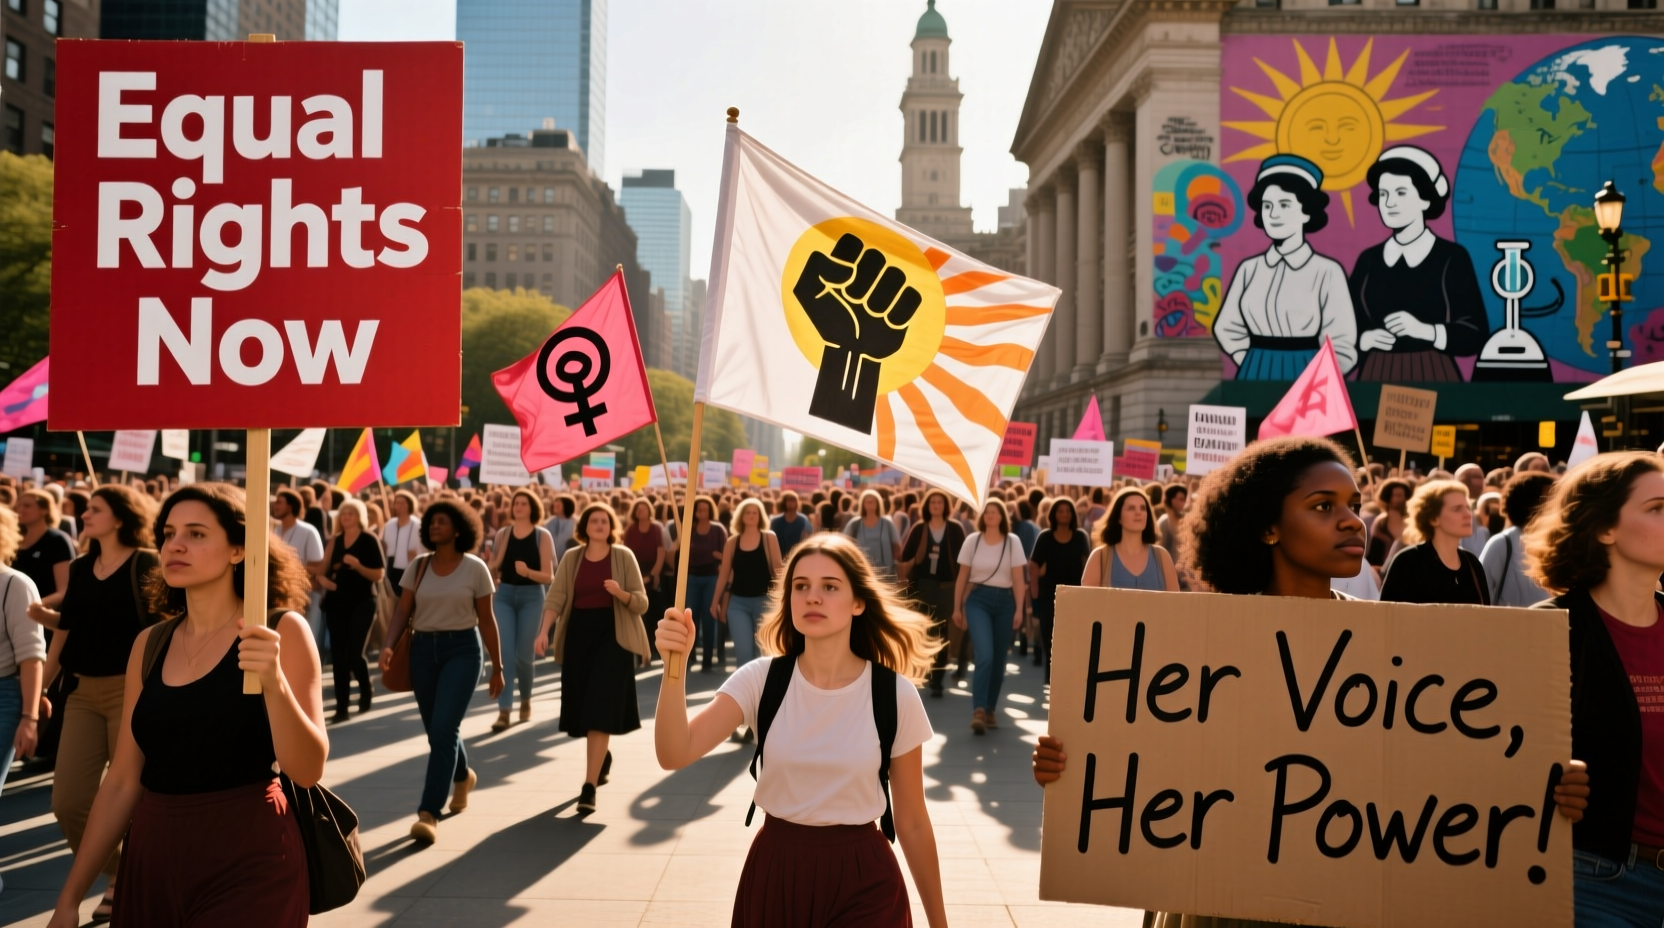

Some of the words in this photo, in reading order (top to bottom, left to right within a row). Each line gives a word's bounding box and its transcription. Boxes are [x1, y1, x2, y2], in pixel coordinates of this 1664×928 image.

[97, 69, 384, 184] Equal
[97, 177, 429, 292] Rights
[137, 297, 381, 387] Now
[1083, 621, 1242, 724] Her
[1276, 629, 1525, 759] Voice,
[1077, 752, 1235, 855] Her
[1263, 754, 1563, 885] Power!
